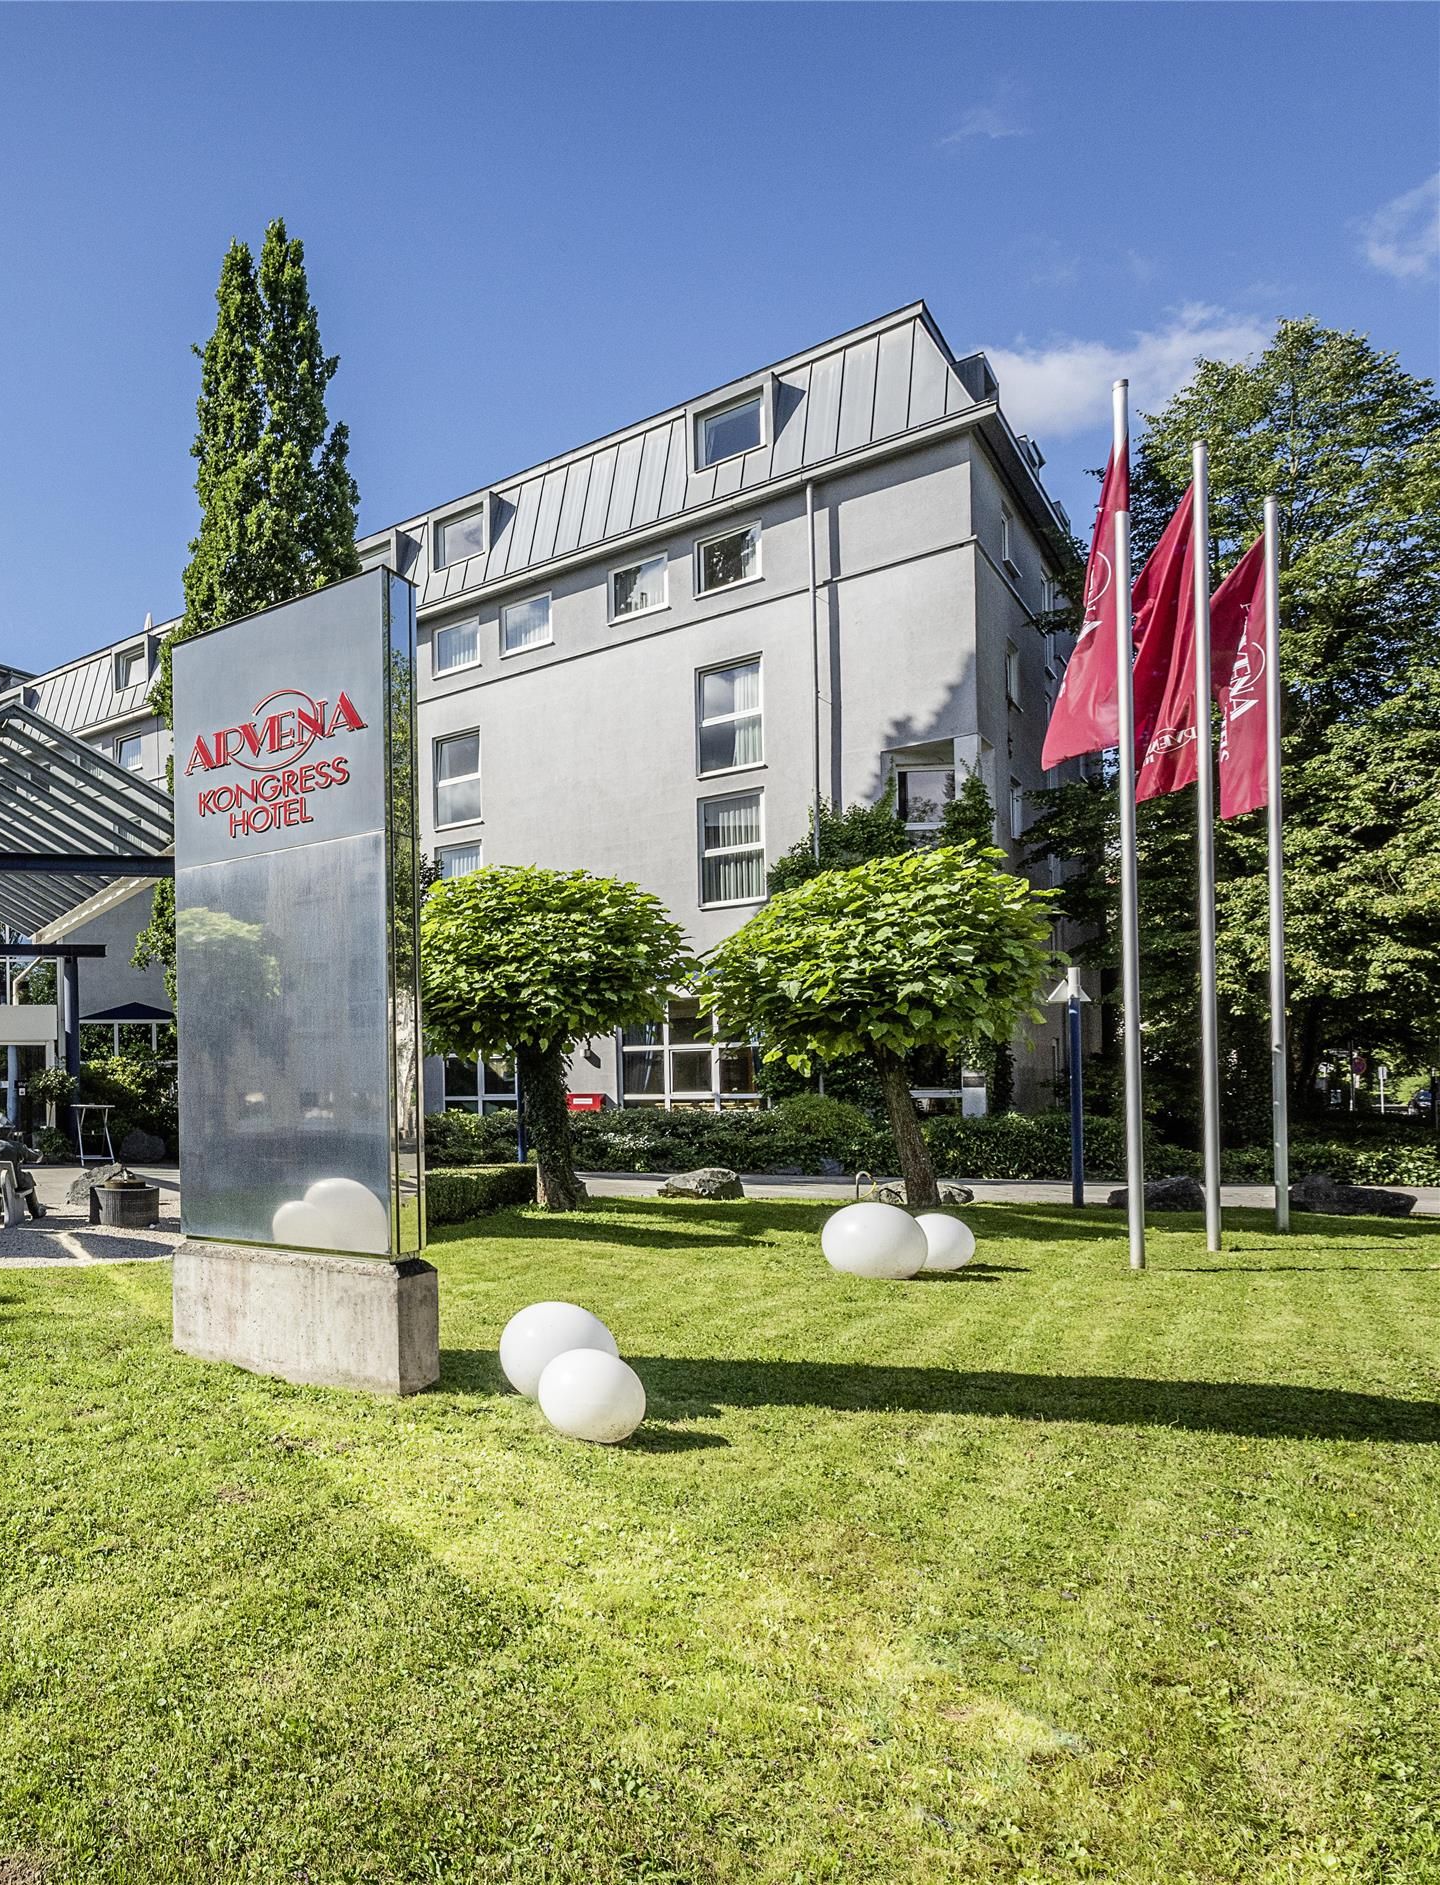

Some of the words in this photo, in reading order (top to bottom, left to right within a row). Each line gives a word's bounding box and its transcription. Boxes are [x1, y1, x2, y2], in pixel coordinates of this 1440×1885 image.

[184, 691, 368, 776] ARVENA
[198, 756, 350, 817] KONGRESS
[229, 797, 314, 838] HOTEL
